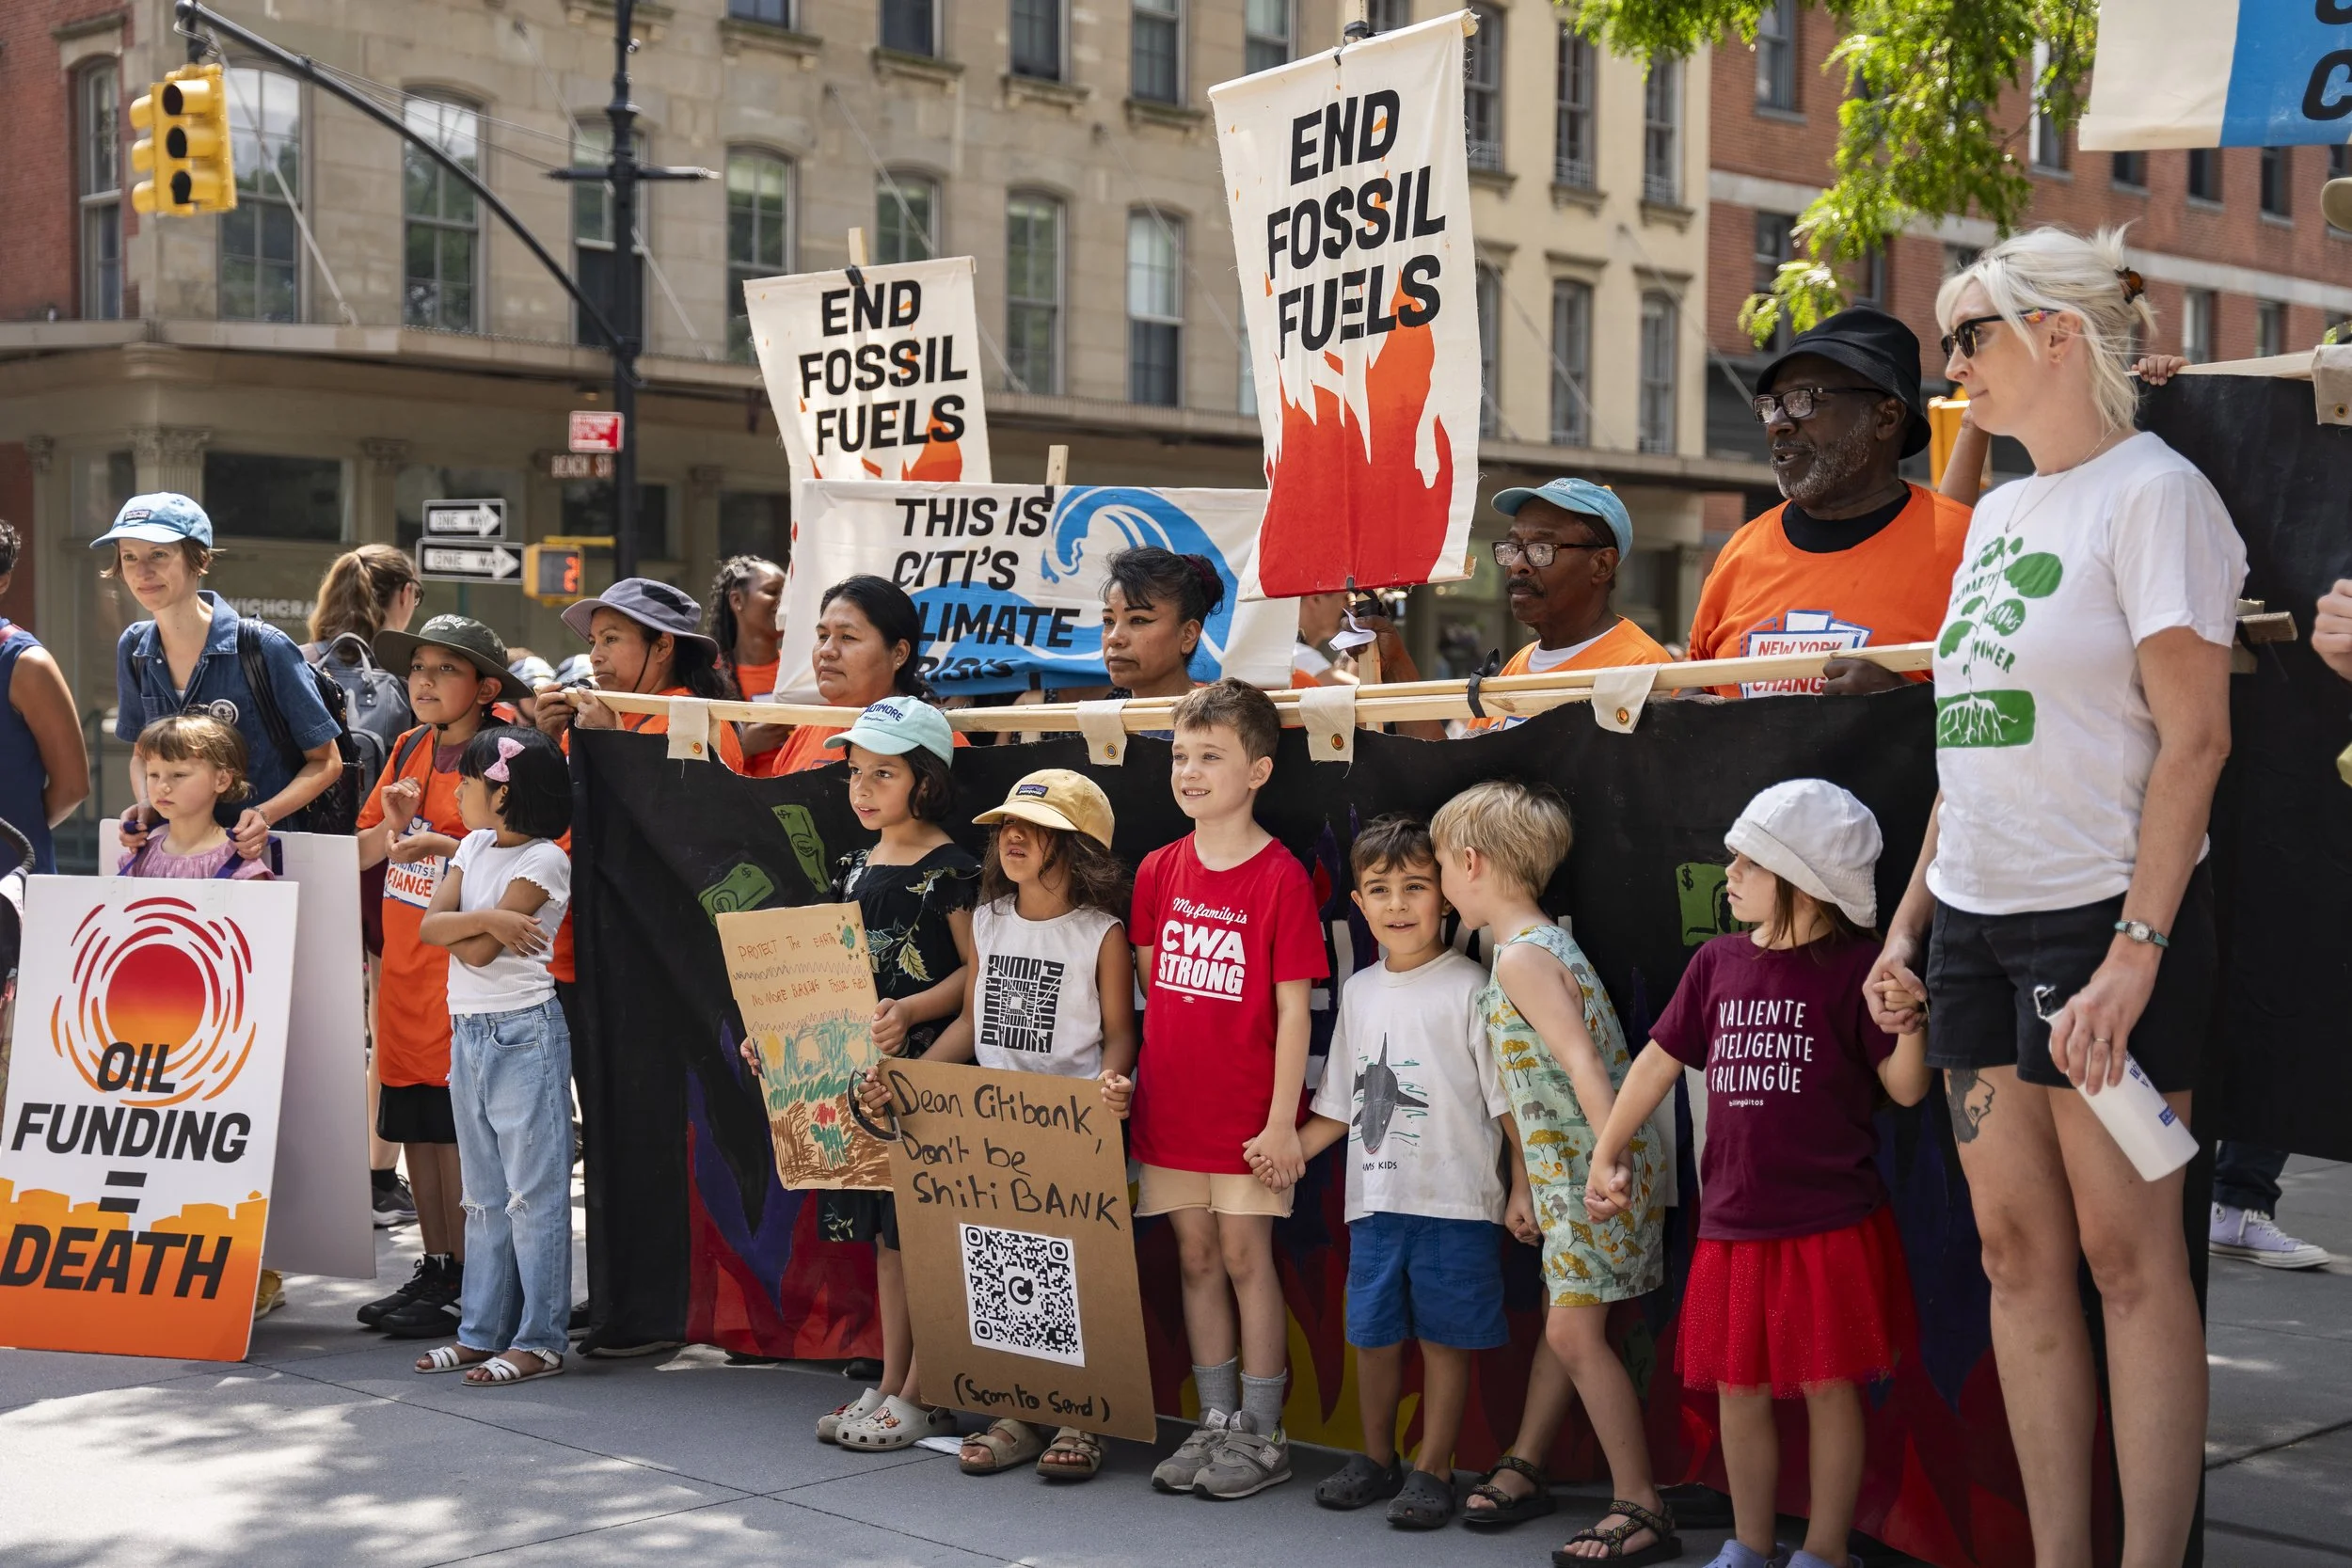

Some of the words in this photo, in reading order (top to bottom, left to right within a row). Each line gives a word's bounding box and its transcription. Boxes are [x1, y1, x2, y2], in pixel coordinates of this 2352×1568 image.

[1290, 89, 1400, 186] END
[1266, 165, 1446, 280] FOSSIL
[821, 279, 921, 337] END
[1279, 255, 1440, 360] FUELS
[798, 335, 968, 399] FOSSIL
[816, 394, 965, 455] FUELS
[436, 513, 458, 528] ONE
[468, 514, 492, 527] WAY
[896, 497, 998, 536] THIS
[1006, 497, 1053, 537] IS
[433, 552, 464, 568] ONE
[477, 555, 506, 569] WAY
[892, 546, 1019, 591] CITI'S
[446, 614, 468, 629] YORK
[918, 602, 1081, 648] LIMATE
[916, 657, 1020, 683] RISIS
[1757, 641, 1797, 656] NEW
[1974, 640, 2016, 673] POWER
[1753, 676, 1828, 694] CHANG
[1173, 897, 1196, 918] My
[1193, 903, 1235, 925] family
[1234, 910, 1248, 925] is
[738, 939, 777, 962] PROTECT
[1162, 919, 1247, 965] CWA
[1158, 951, 1246, 995] STRONG
[766, 989, 788, 1005] MORE
[1719, 999, 1807, 1029] VALIENTE
[97, 1041, 177, 1094] OIL
[10, 1102, 252, 1164] FUNDING
[900, 1130, 970, 1165] Don't
[984, 1137, 1031, 1178] be
[1378, 1161, 1398, 1170] KIDS
[913, 1172, 998, 1210] Shiti
[1010, 1178, 1125, 1231] BANK
[0, 1224, 233, 1300] DEATH
